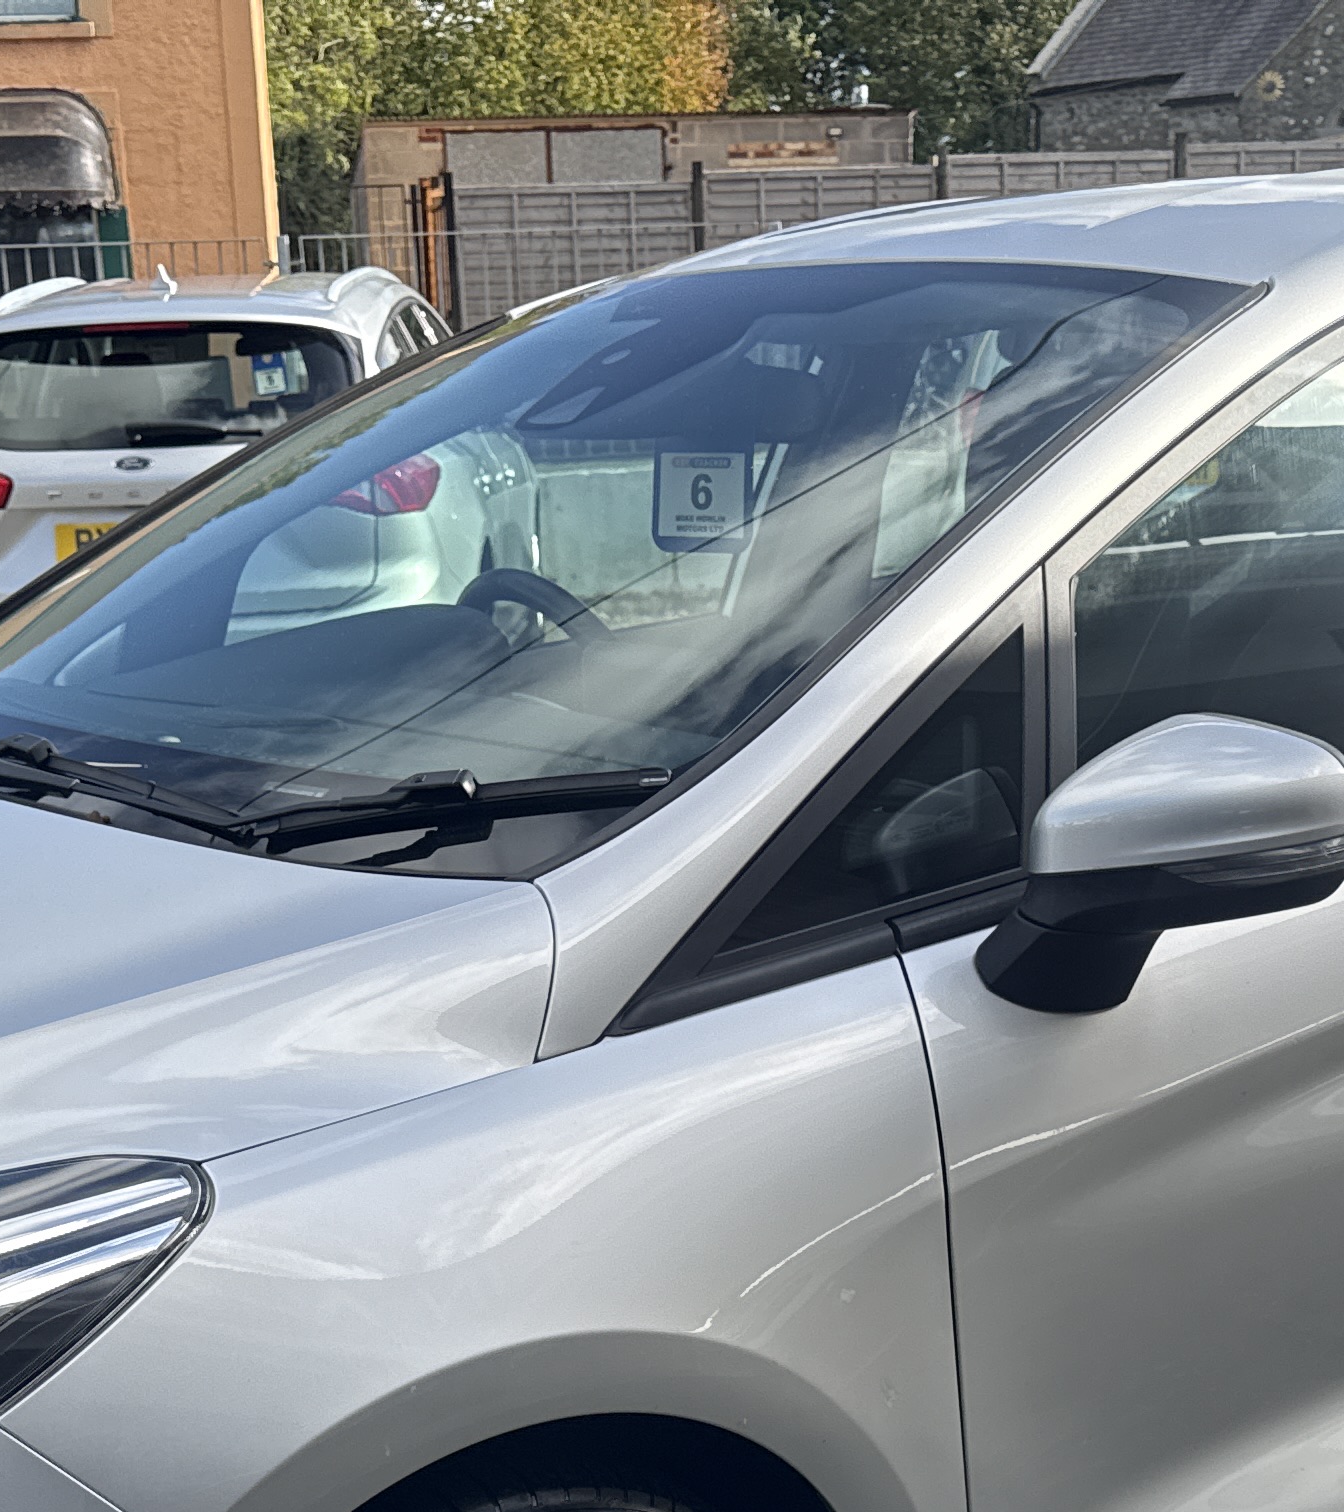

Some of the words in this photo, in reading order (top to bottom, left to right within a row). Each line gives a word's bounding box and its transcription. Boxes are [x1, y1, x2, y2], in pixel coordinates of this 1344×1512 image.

[691, 473, 713, 511] 6
[676, 524, 708, 532] MOTORS
[709, 524, 725, 533] LTD
